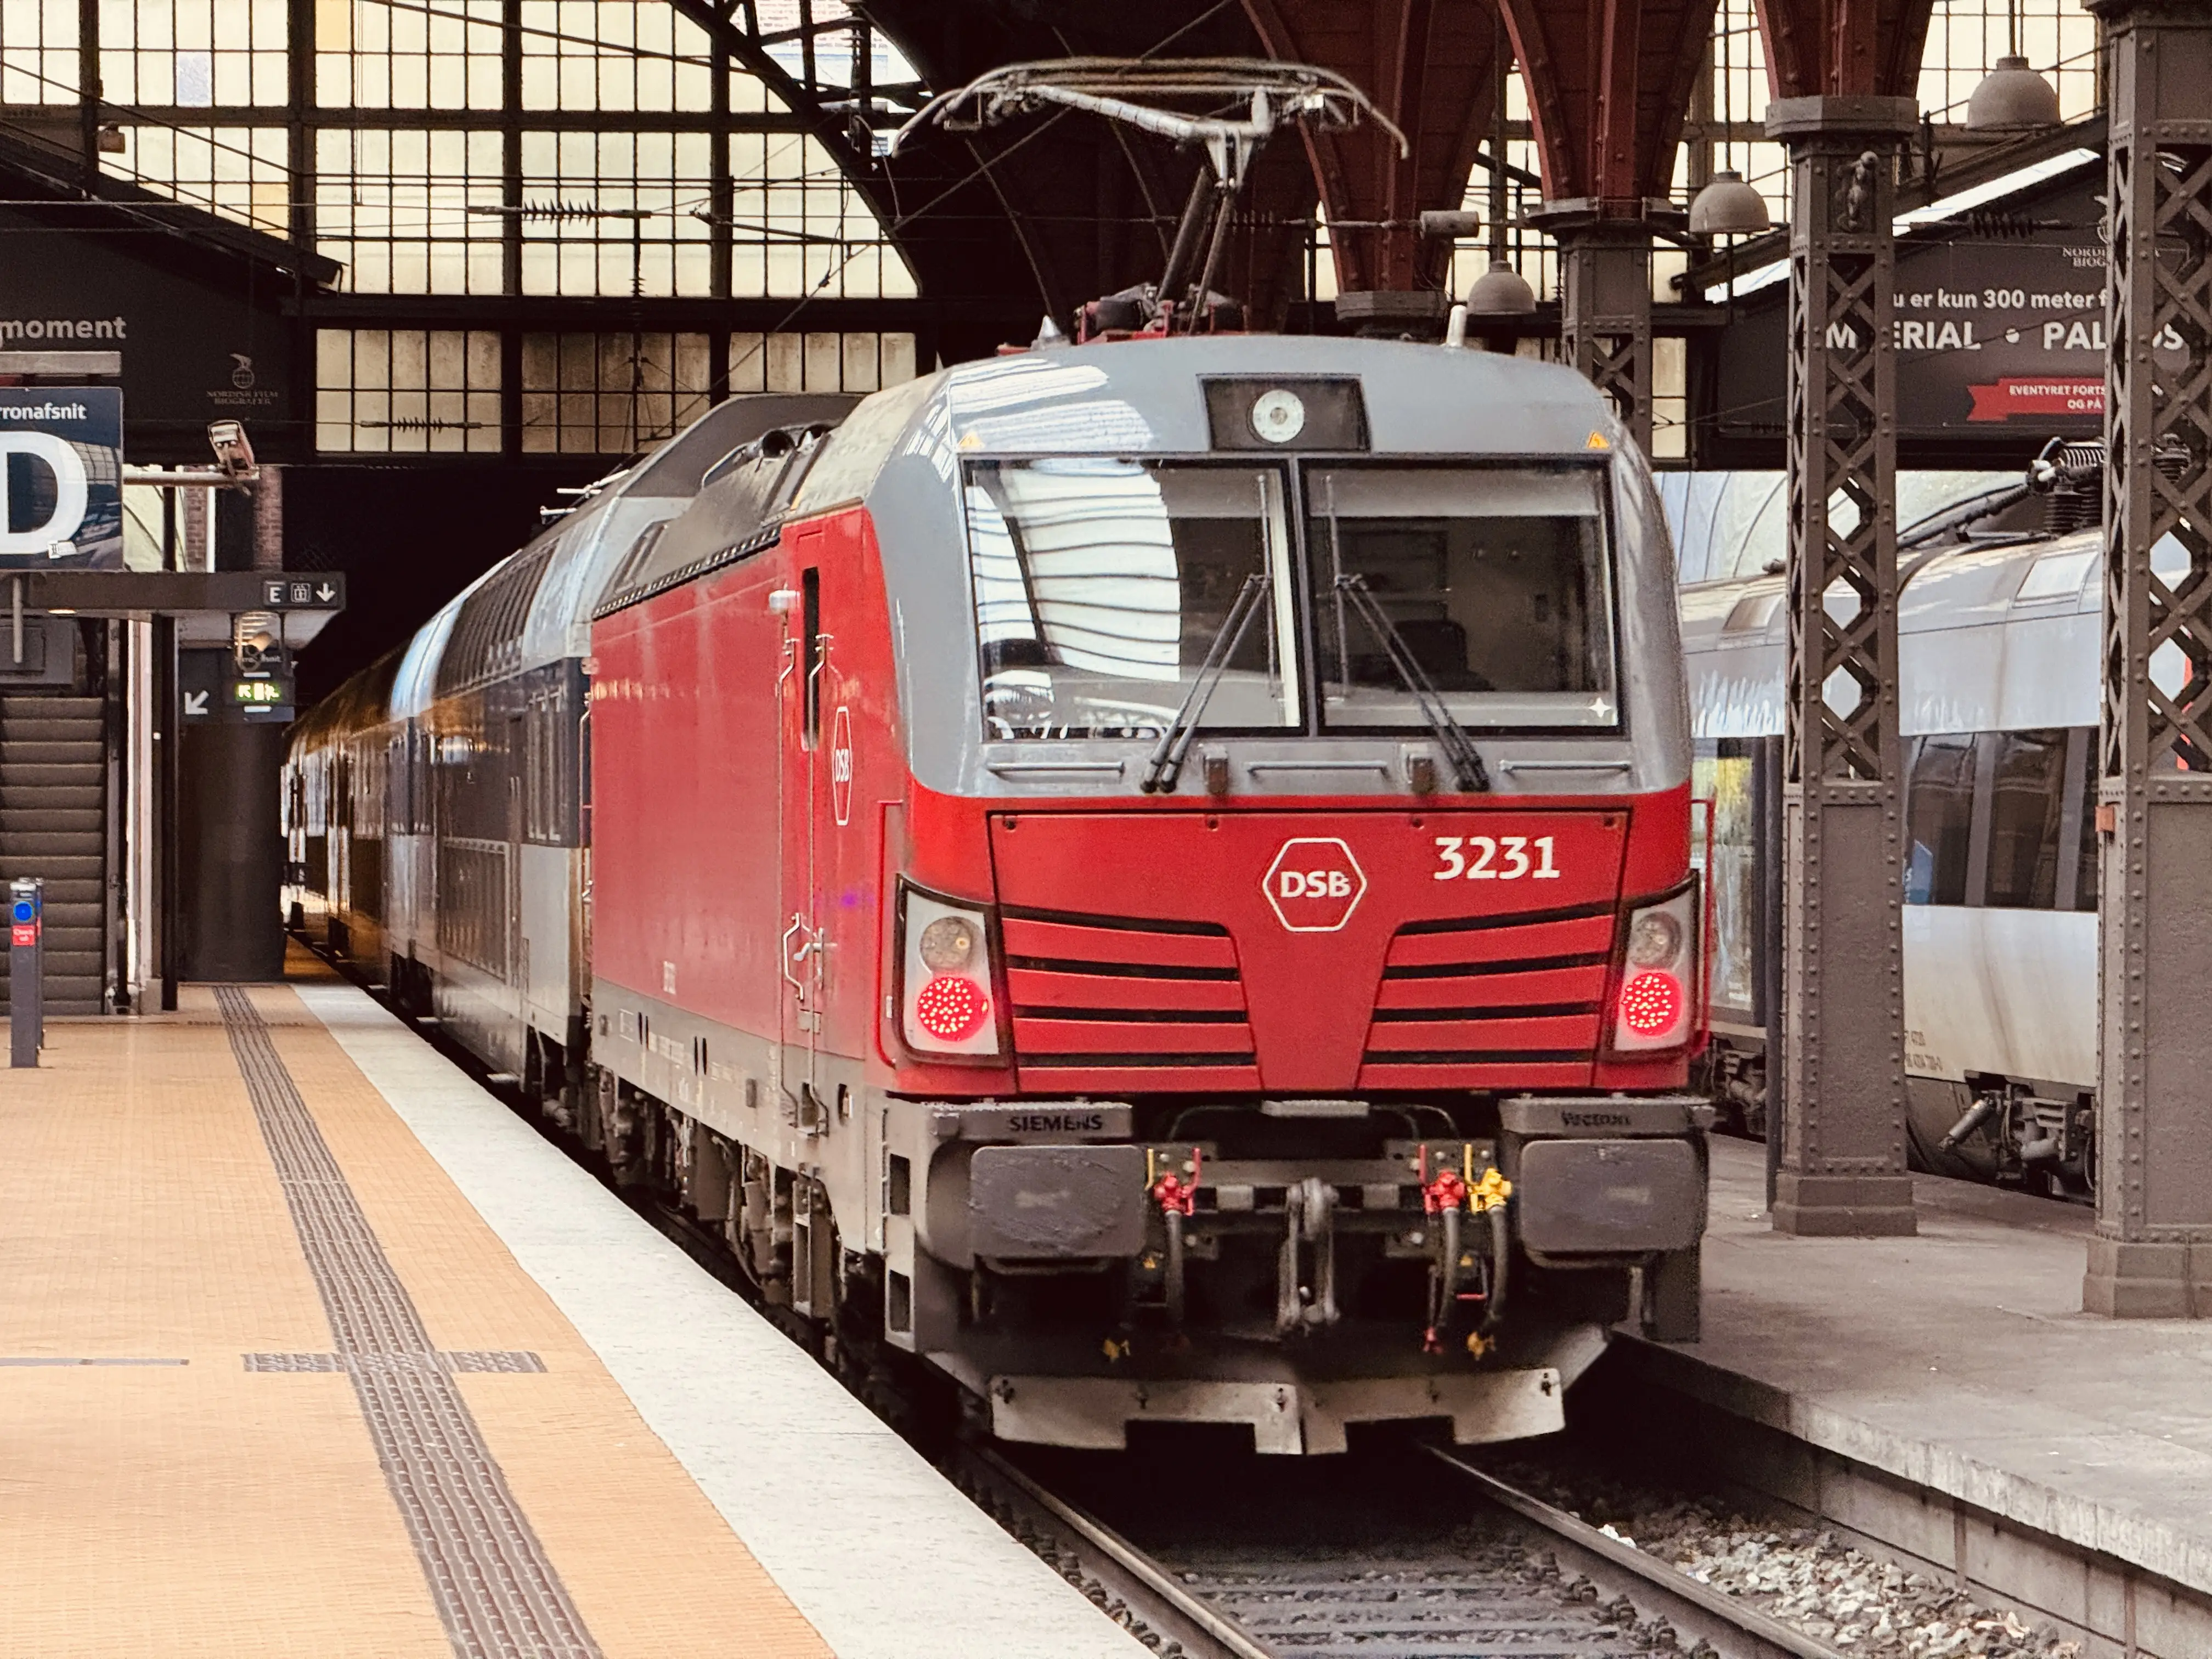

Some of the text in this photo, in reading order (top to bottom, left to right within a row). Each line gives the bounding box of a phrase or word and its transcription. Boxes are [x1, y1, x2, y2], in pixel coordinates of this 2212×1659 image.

[2063, 247, 2105, 257] NORDI
[2073, 256, 2106, 267] BIOG
[1893, 294, 1905, 308] u
[1910, 294, 1933, 308] er
[1938, 288, 1977, 308] kun
[1983, 289, 2024, 308] 300
[2031, 291, 2094, 308] meter
[2044, 321, 2184, 350] PALS
[2010, 385, 2107, 396] EVENTYRET FORTS
[0, 403, 87, 420] ronafsnit
[2067, 399, 2085, 409] OG
[0, 431, 88, 555] D
[270, 586, 281, 603] E
[836, 749, 849, 782] DSB
[1434, 837, 1560, 879] 3231
[1280, 871, 1351, 898] DSB
[1009, 1115, 1103, 1131] SIEMENS
